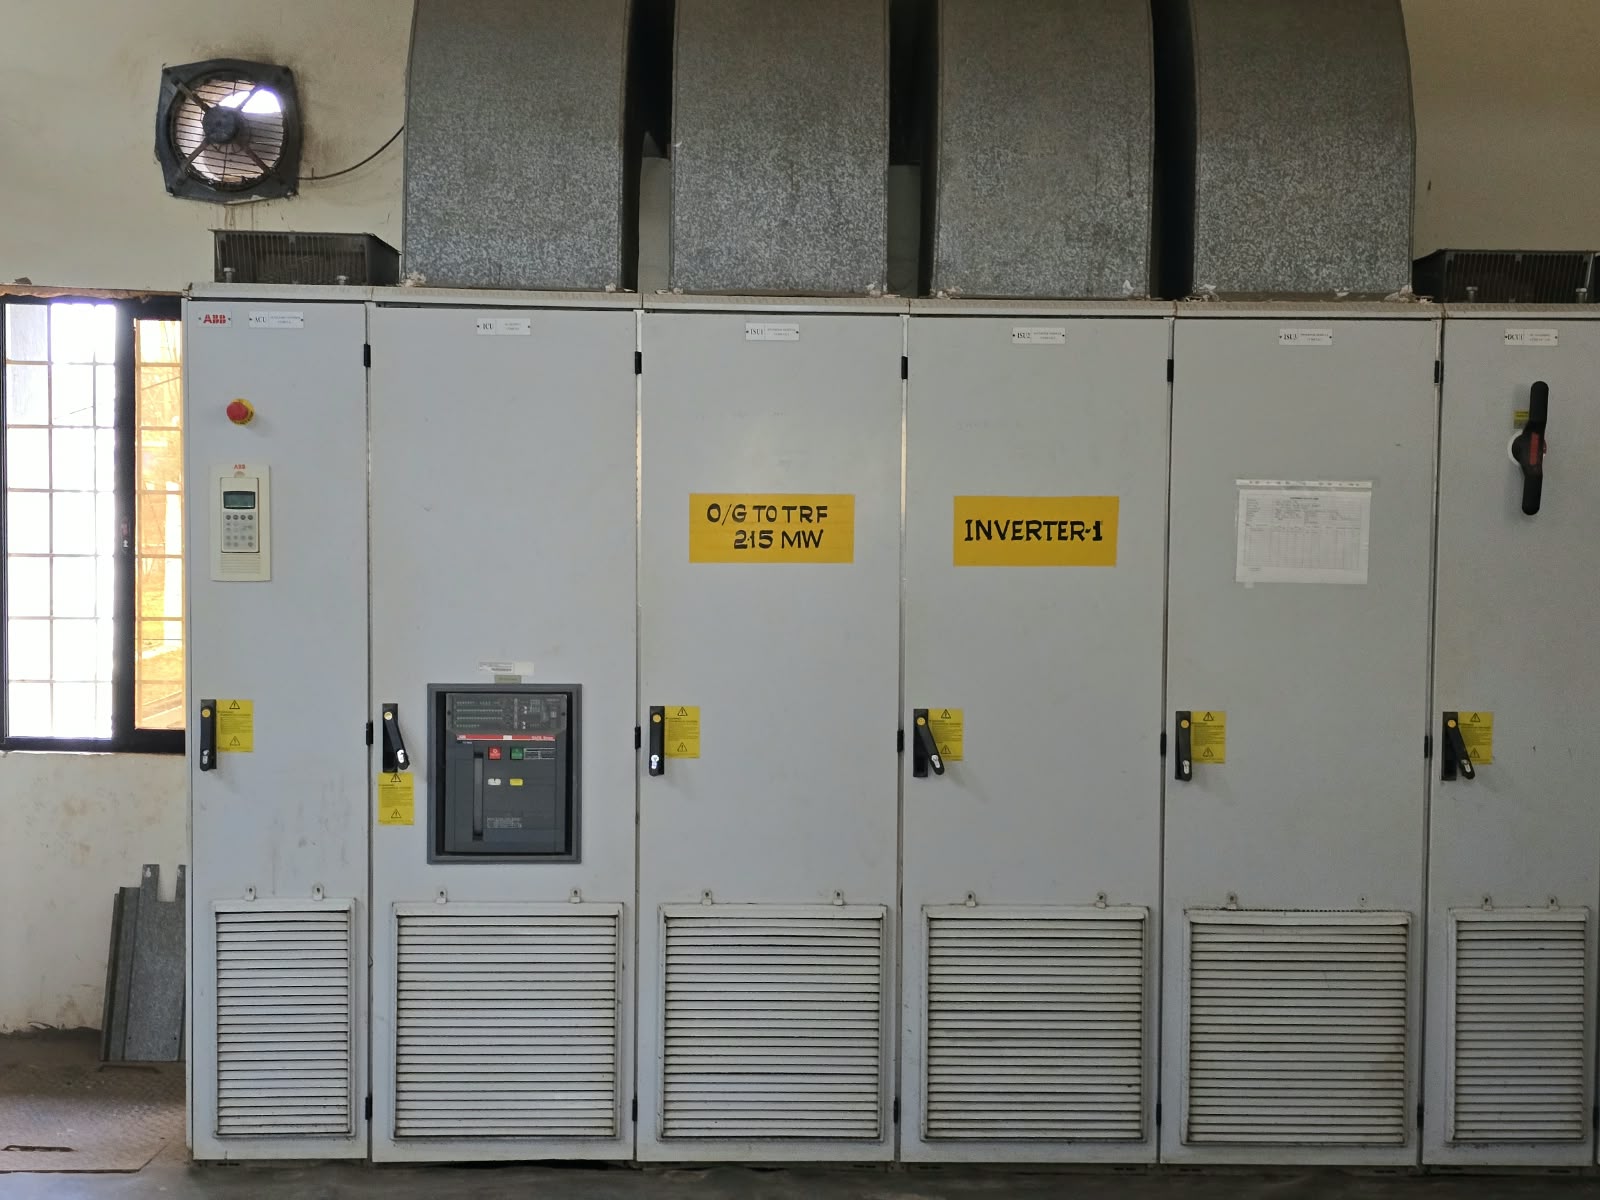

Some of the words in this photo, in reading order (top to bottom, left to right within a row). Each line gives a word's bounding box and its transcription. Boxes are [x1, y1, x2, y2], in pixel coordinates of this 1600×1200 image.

[203, 313, 227, 324] ABB
[706, 503, 747, 526] O/G
[752, 505, 778, 523] TO
[781, 505, 828, 523] TRF
[781, 529, 824, 548] MW
[964, 519, 1104, 541] INVERTER-1
